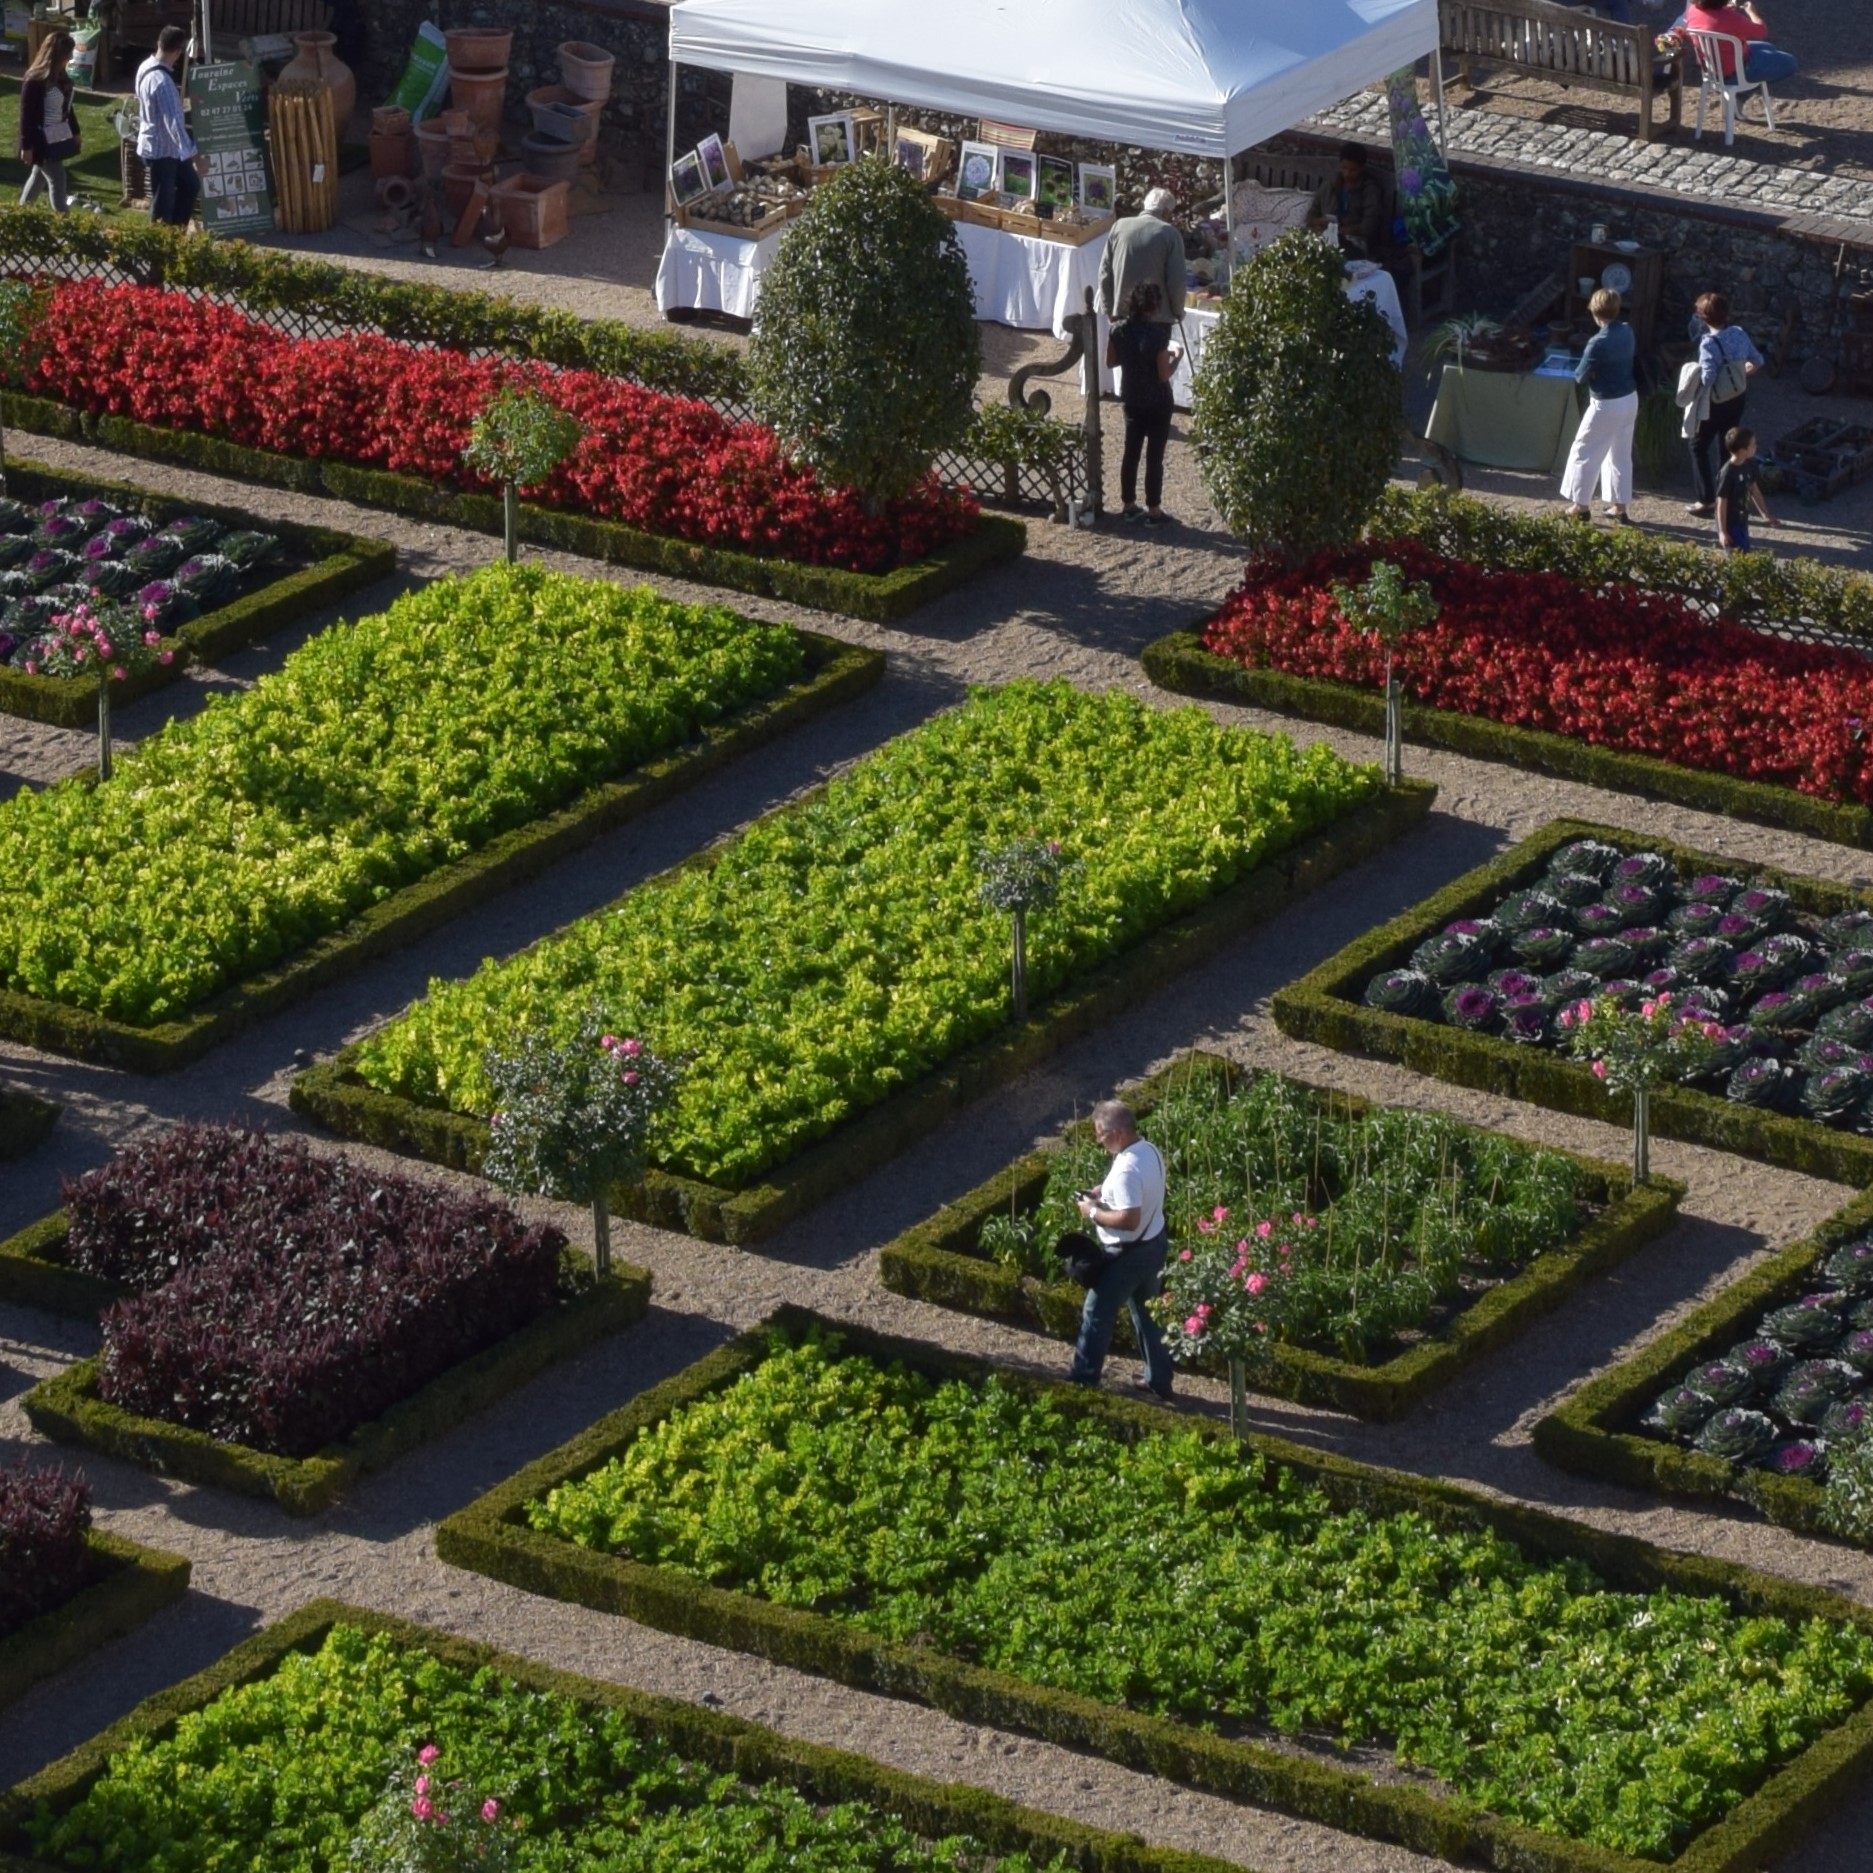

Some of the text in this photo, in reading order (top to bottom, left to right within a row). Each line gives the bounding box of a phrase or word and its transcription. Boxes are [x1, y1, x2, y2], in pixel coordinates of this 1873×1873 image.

[190, 64, 234, 80] Touraine
[208, 78, 247, 92] Espaces
[235, 90, 259, 103] Verts
